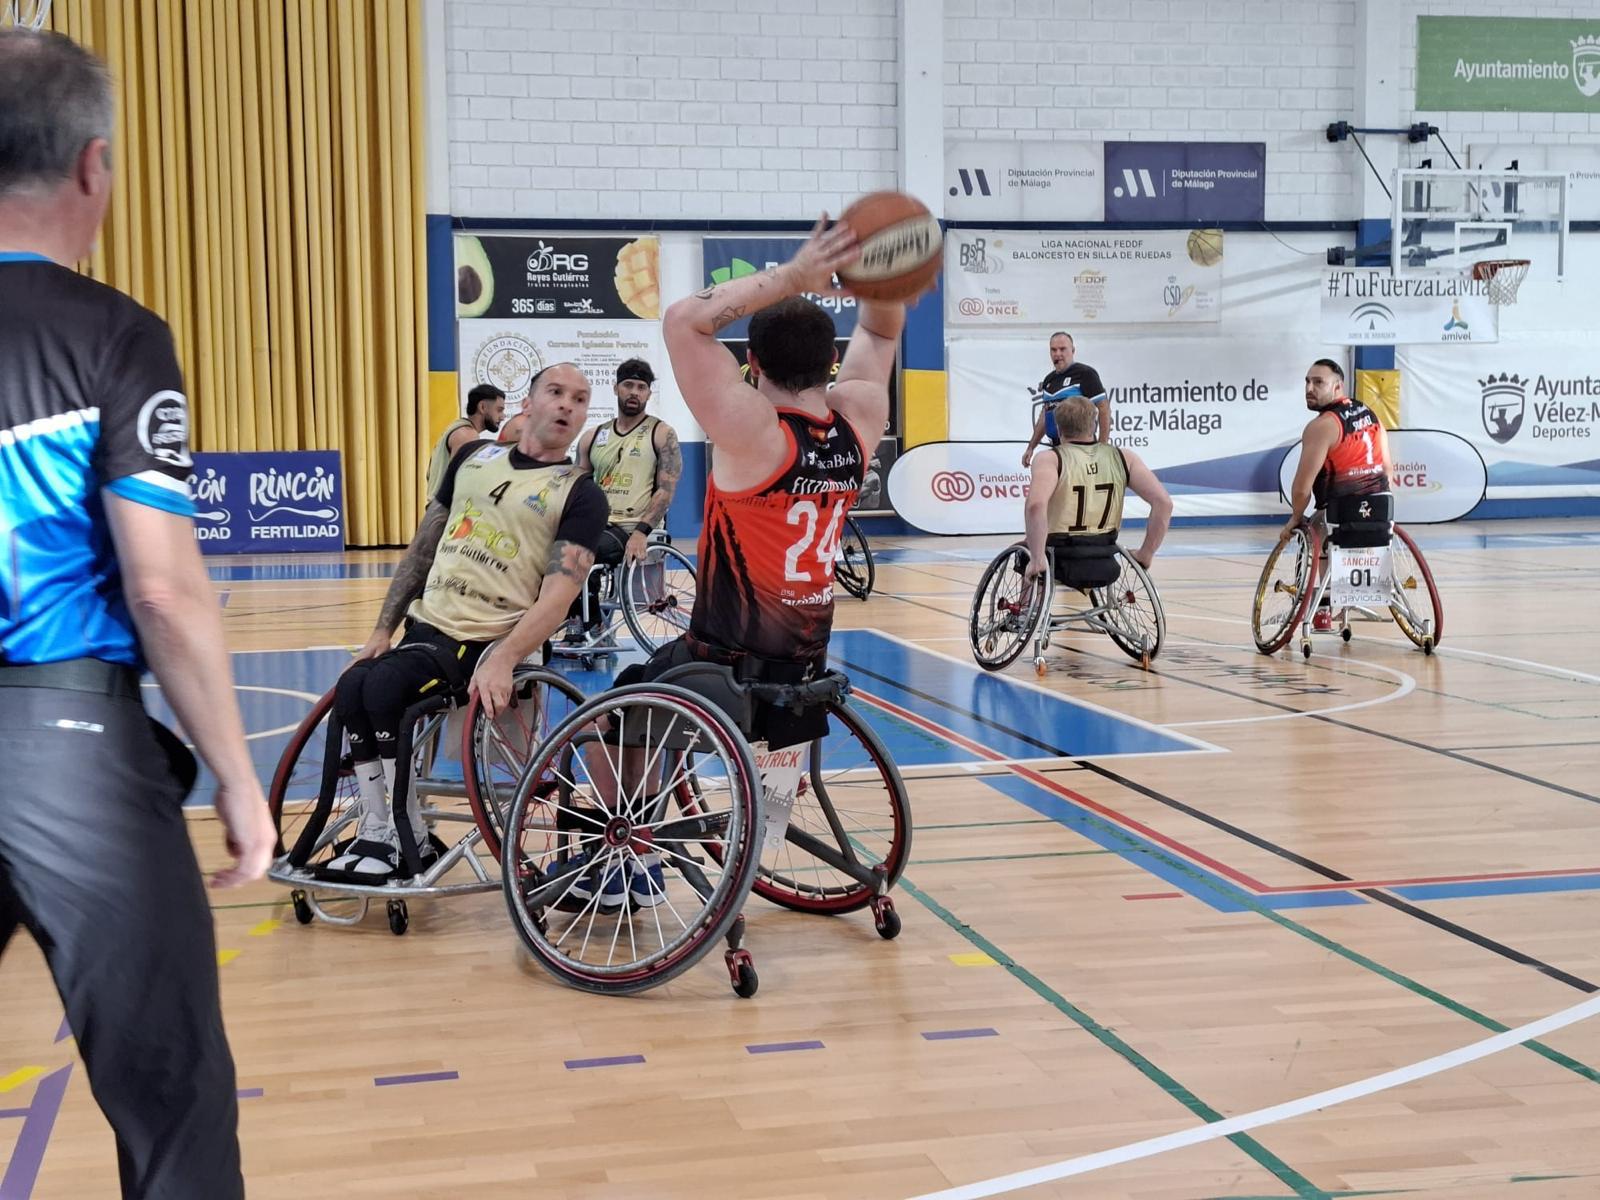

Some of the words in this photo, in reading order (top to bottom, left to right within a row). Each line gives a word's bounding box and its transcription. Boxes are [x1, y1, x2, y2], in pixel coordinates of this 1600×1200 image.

[1454, 58, 1569, 82] Ayuntamiento
[1008, 168, 1053, 178] Diputación
[1054, 168, 1095, 177] Provincial
[1171, 169, 1216, 179] Diputación
[1217, 169, 1258, 178] Provincial
[1008, 179, 1019, 187] de
[1020, 179, 1052, 188] Málaga
[1171, 180, 1183, 188] de
[1184, 180, 1215, 190] Málaga
[1041, 240, 1062, 249] LIGA
[1064, 240, 1112, 249] NACIONAL
[1113, 240, 1143, 249] FEDDF
[1012, 251, 1075, 260] BALONCESTO
[1077, 251, 1090, 260] EN
[1092, 251, 1118, 260] SILLA
[1120, 251, 1132, 260] DE
[1134, 251, 1172, 260] RUEDAS
[526, 272, 551, 284] Reyes
[552, 272, 589, 281] Gutiérrez
[1163, 285, 1181, 306] CSD
[511, 298, 534, 313] 365
[536, 300, 555, 311] días
[986, 306, 1019, 315] ONCE
[1107, 380, 1237, 403] yuntamiento
[1242, 378, 1269, 401] de
[1534, 374, 1600, 401] Ayunta
[1532, 425, 1591, 441] Deportes
[1362, 431, 1374, 465] 1
[979, 472, 1031, 483] Fundación
[488, 480, 513, 506] 4
[980, 484, 1031, 499] ONCE
[1068, 483, 1114, 532] 17
[251, 525, 340, 539] FERTILIDAD
[784, 498, 846, 583] 24
[1350, 568, 1371, 588] 01
